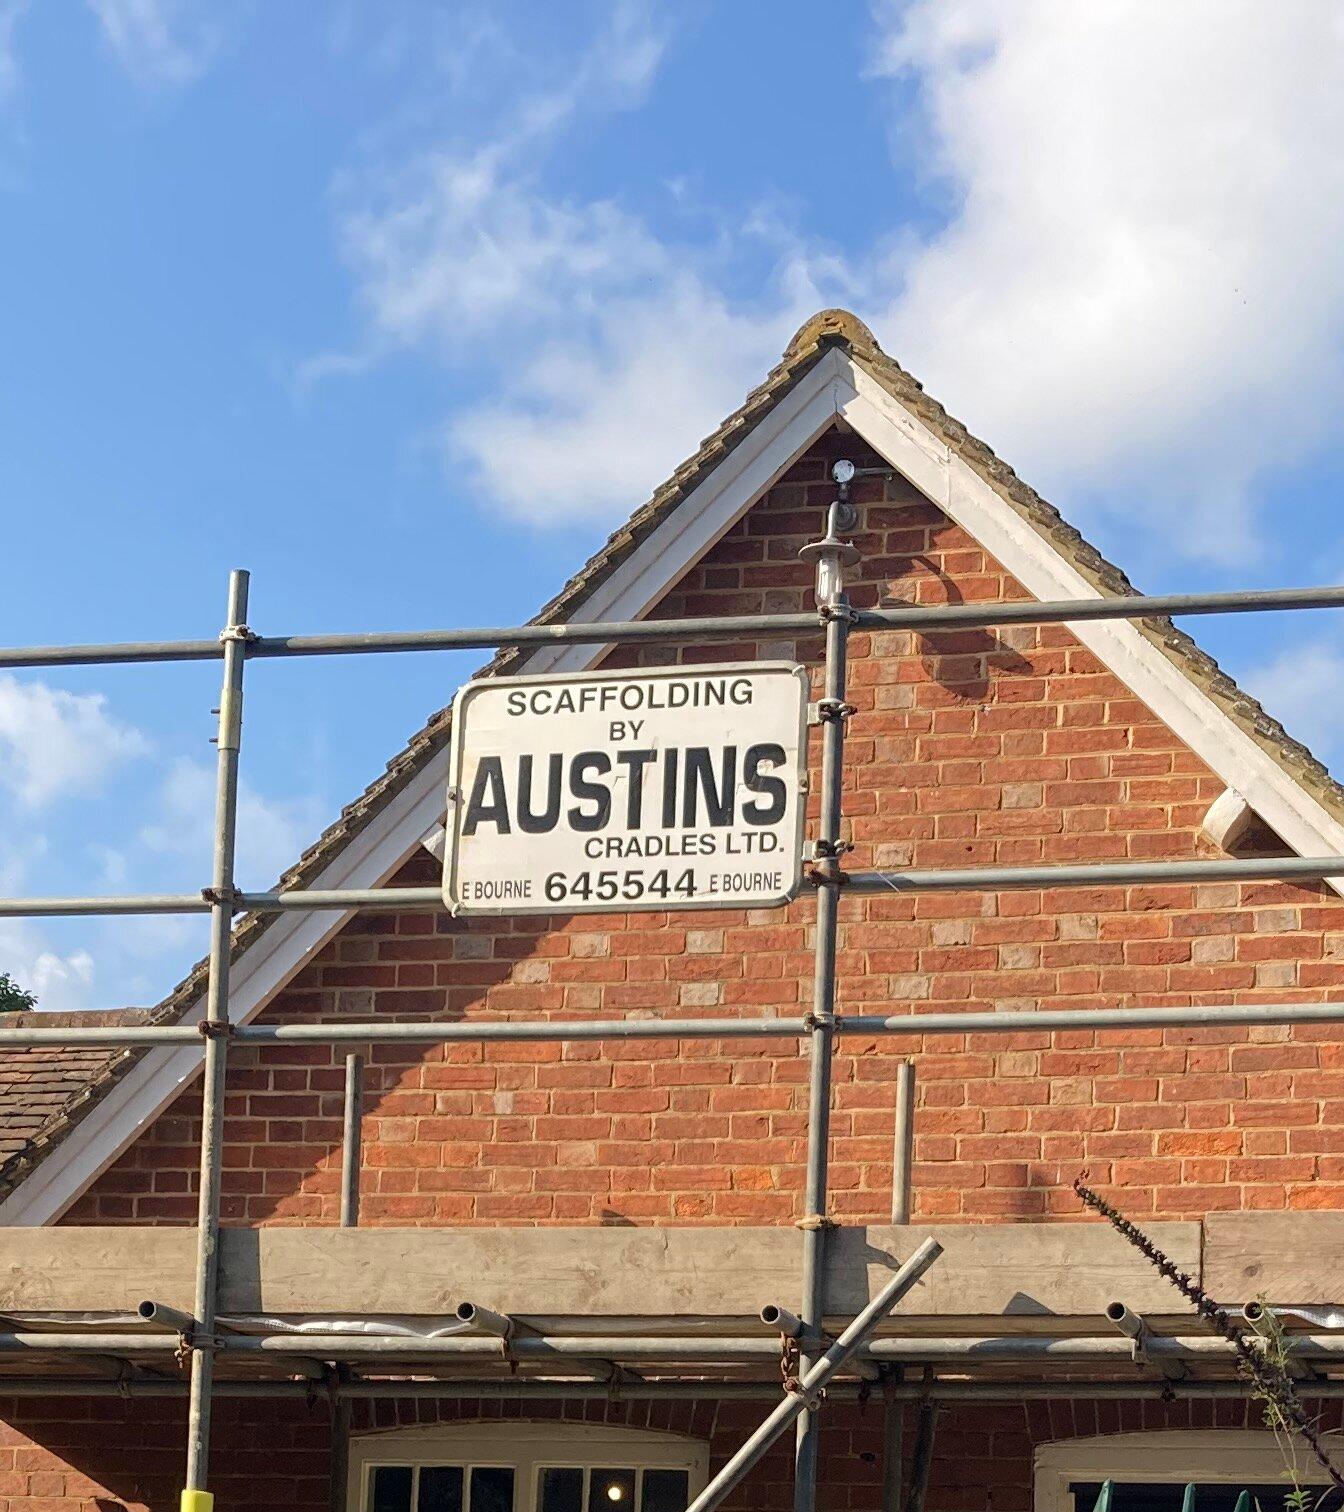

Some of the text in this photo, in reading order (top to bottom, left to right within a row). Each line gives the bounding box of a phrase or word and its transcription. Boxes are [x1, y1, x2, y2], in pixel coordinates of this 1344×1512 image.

[507, 679, 754, 717] SCAFFOLDING
[609, 720, 645, 742] BY
[461, 742, 788, 836] AUSTINS
[584, 831, 785, 859] CRADLES LTD.
[544, 868, 698, 902] 645544
